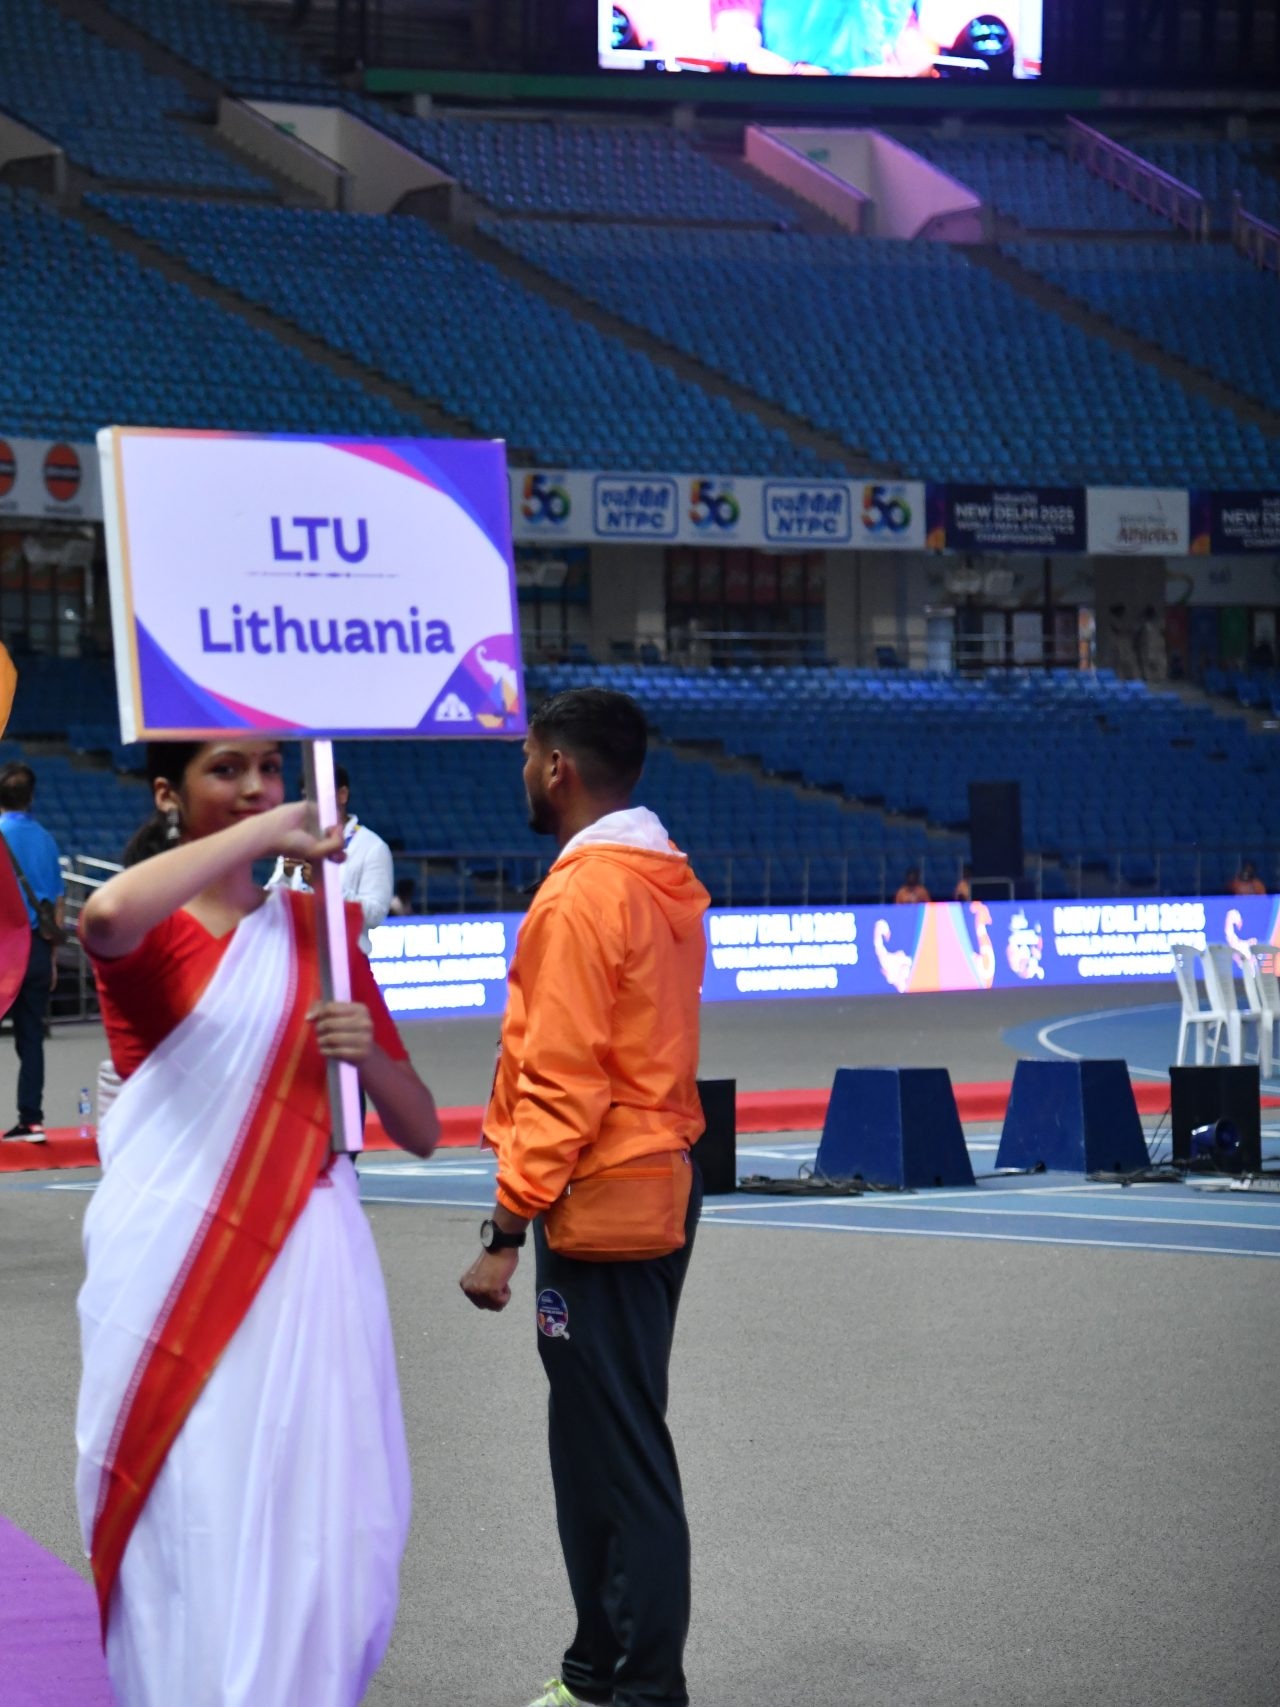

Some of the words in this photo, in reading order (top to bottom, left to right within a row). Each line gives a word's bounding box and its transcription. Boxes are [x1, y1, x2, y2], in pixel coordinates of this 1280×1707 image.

[954, 503, 992, 520] NEW
[606, 513, 665, 529] NTPC
[778, 517, 838, 534] NTPC
[270, 516, 370, 564] LTU
[198, 604, 455, 655] Lithuania
